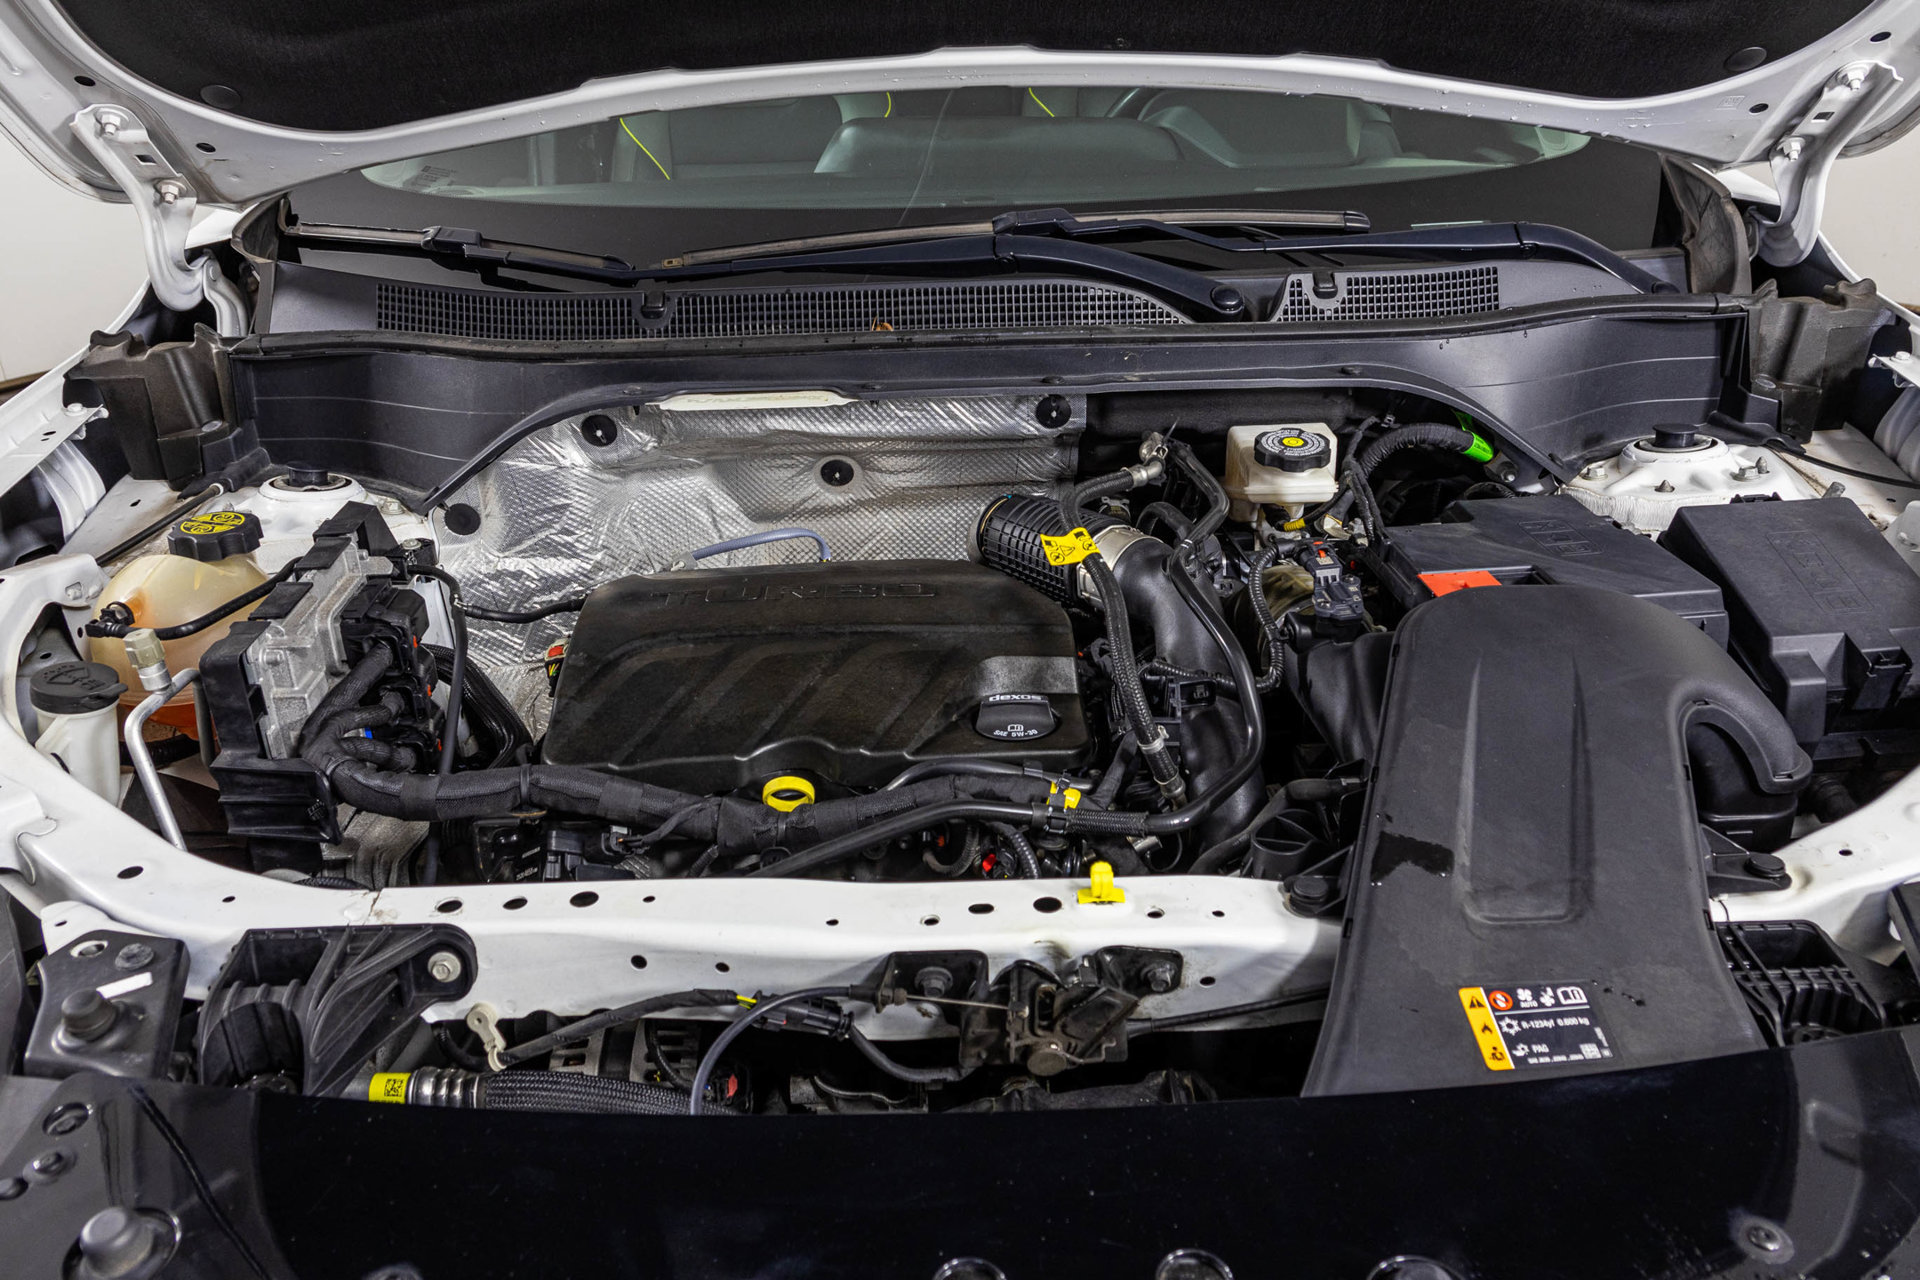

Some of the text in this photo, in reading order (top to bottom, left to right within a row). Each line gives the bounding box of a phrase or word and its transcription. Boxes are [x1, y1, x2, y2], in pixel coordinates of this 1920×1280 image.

[650, 583, 937, 606] TURBO
[989, 694, 1042, 702] dexos
[993, 729, 1009, 737] SAE
[1578, 1016, 1590, 1026] kg
[1532, 1044, 1549, 1053] PAG
